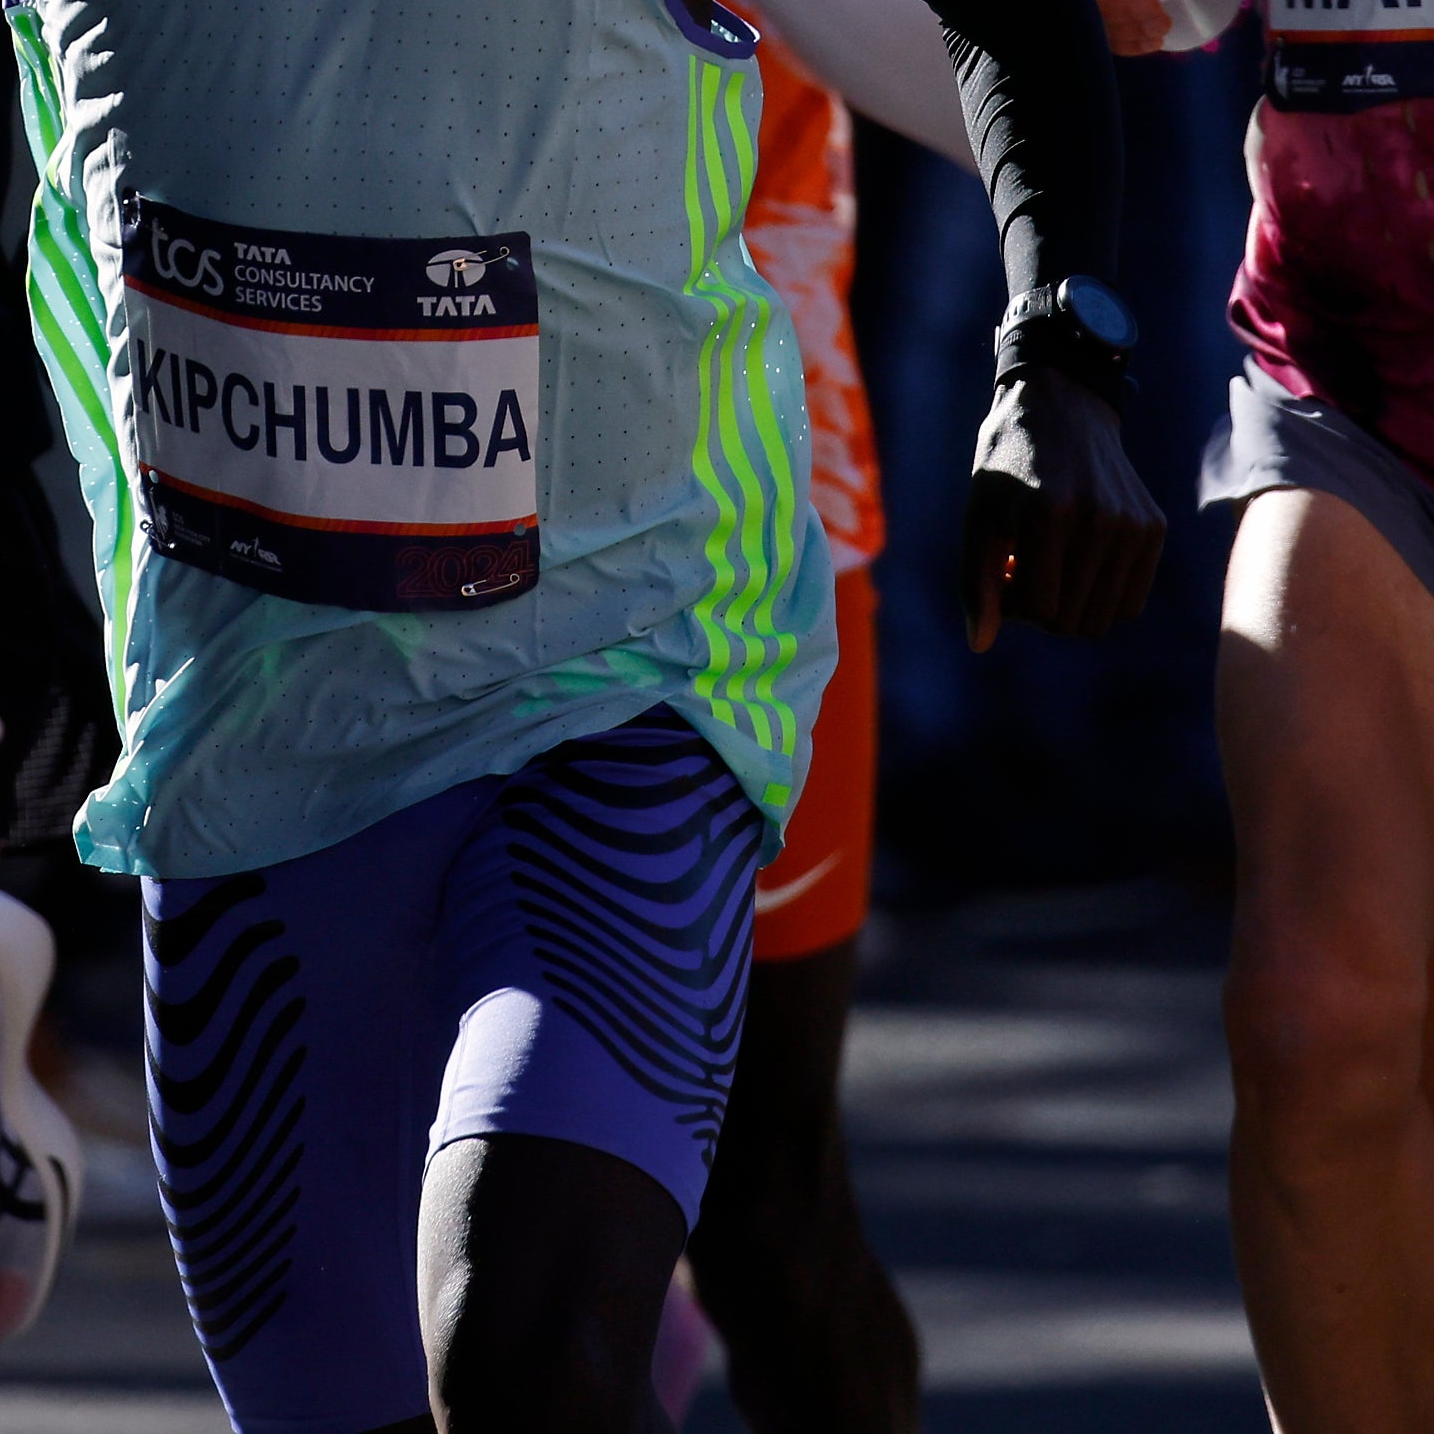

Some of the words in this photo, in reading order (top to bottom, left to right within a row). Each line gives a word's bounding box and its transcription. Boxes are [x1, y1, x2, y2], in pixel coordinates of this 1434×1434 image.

[151, 216, 226, 297] tcs
[233, 241, 292, 266] TATA
[234, 263, 375, 294] CONSULTANCY
[235, 288, 323, 313] SERVICES
[417, 294, 497, 318] TATA
[137, 338, 532, 469] KIPCHUMBA
